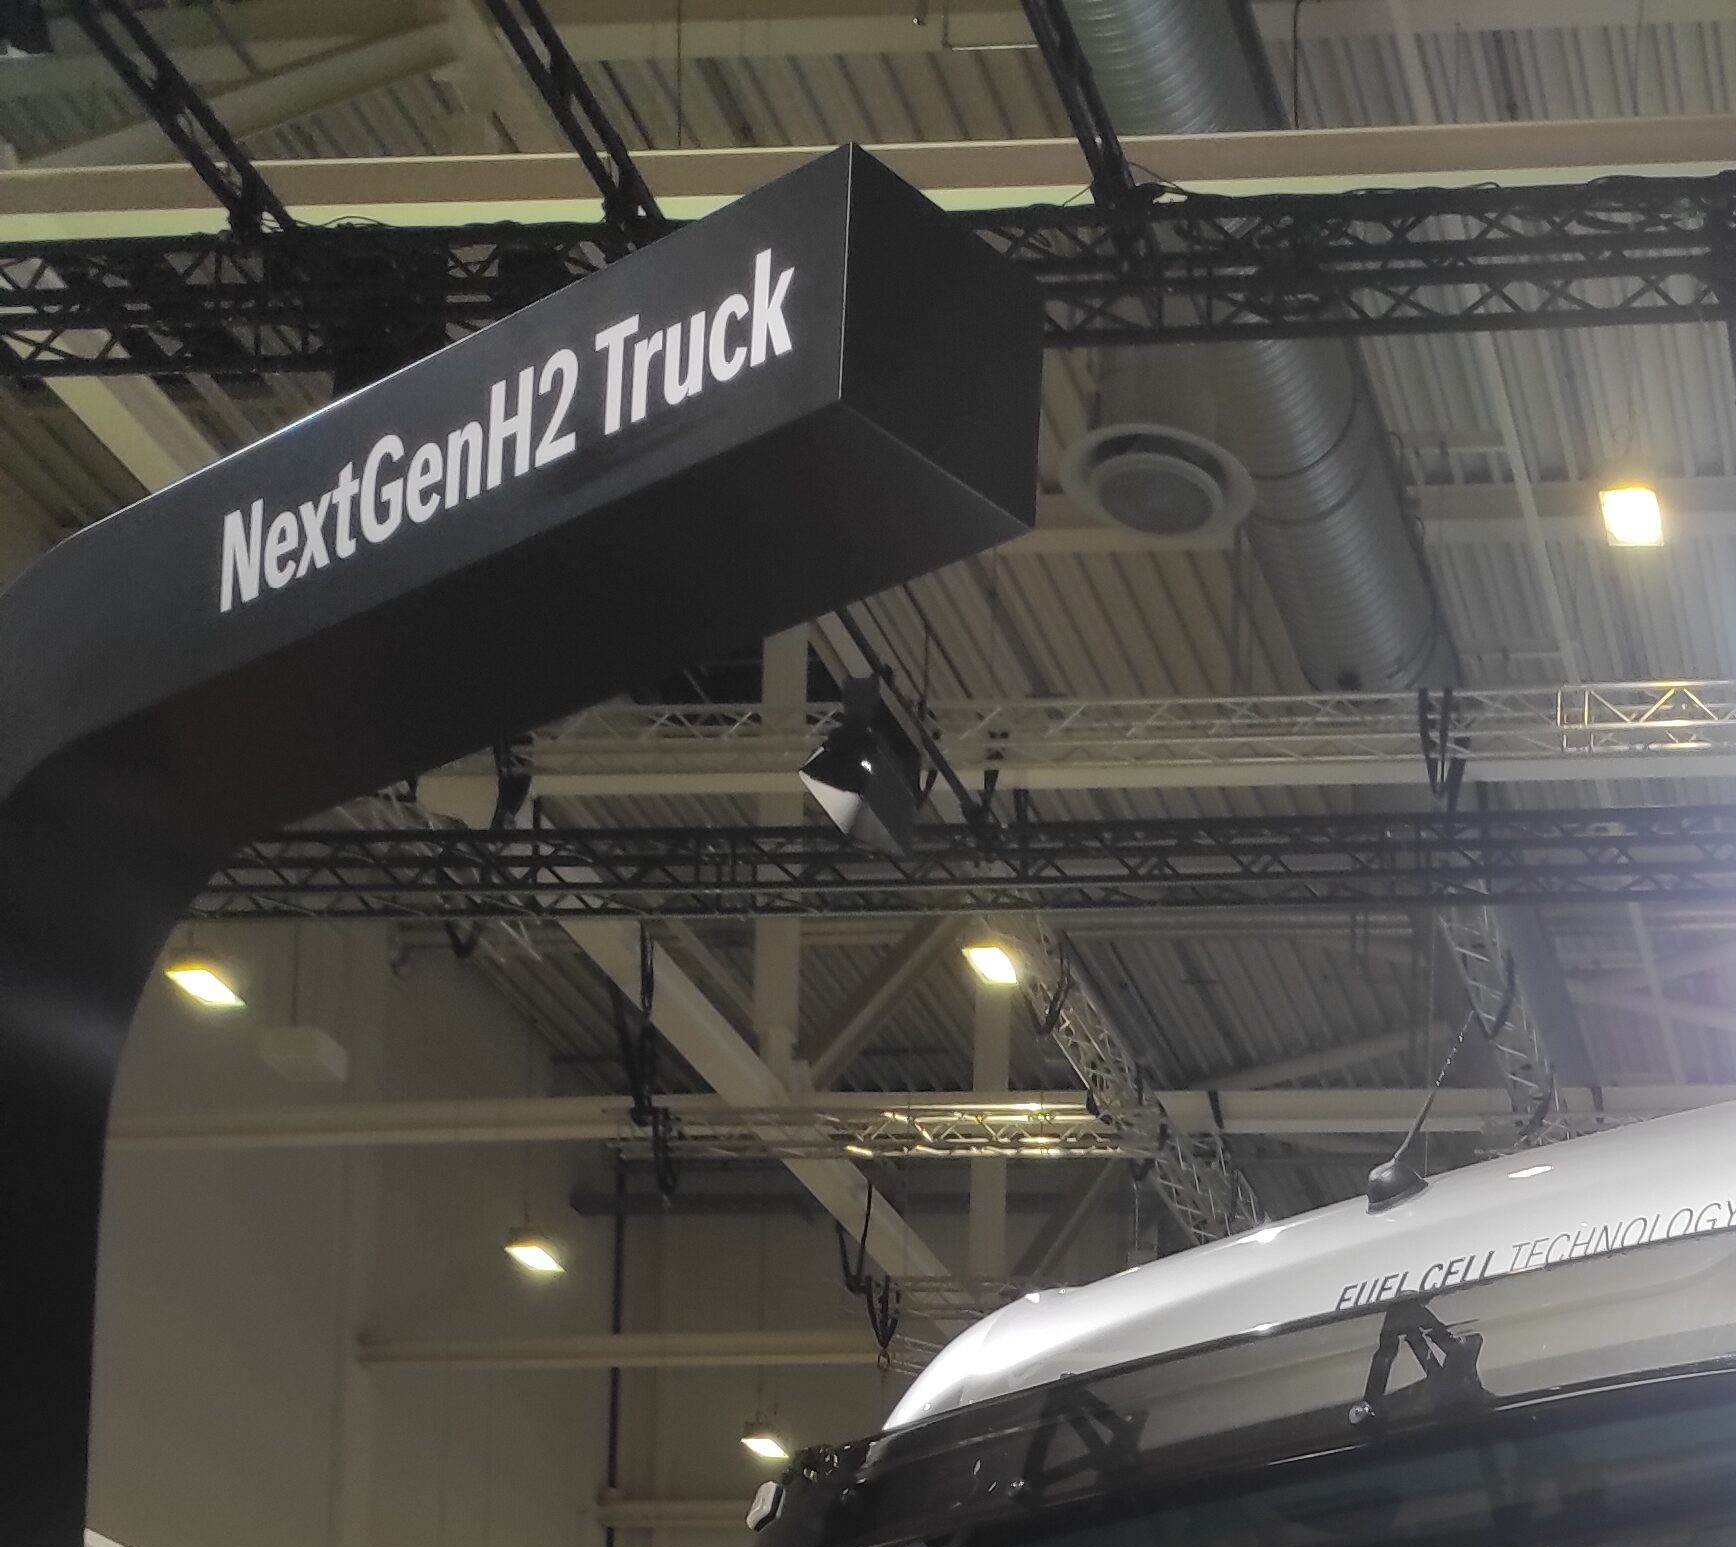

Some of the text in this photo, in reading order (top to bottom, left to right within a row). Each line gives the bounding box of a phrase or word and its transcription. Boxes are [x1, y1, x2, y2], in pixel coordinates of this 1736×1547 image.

[218, 248, 796, 613] NextGenH2 Truck
[1419, 1250, 1496, 1294] CELL
